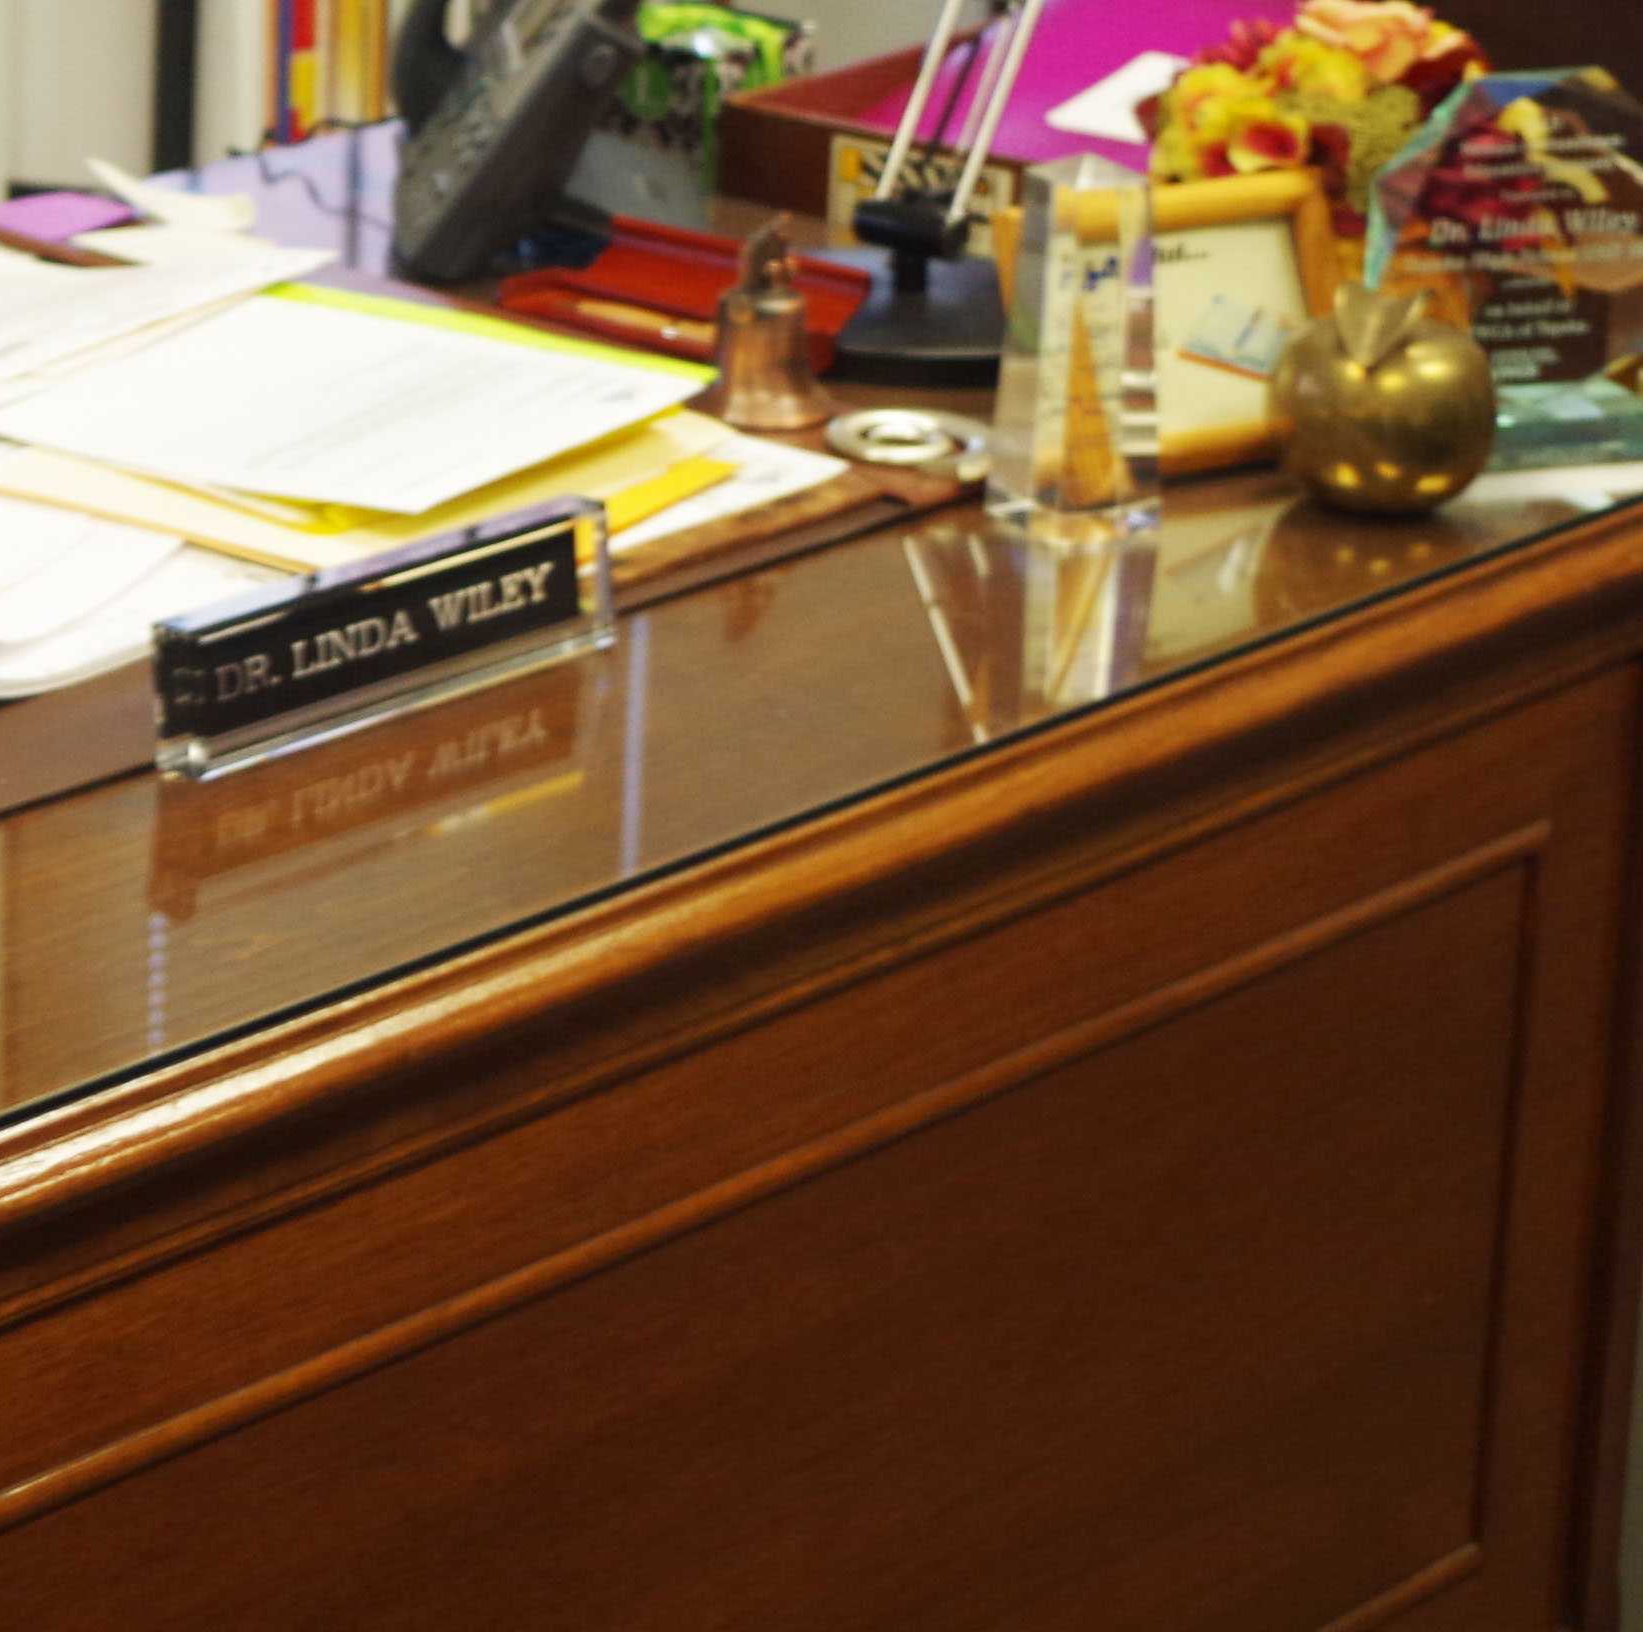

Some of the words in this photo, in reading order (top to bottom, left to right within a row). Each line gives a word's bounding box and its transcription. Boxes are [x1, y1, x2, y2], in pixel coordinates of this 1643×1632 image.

[216, 652, 283, 702] DR.
[290, 609, 420, 679] LINDA
[426, 560, 556, 632] WILEY
